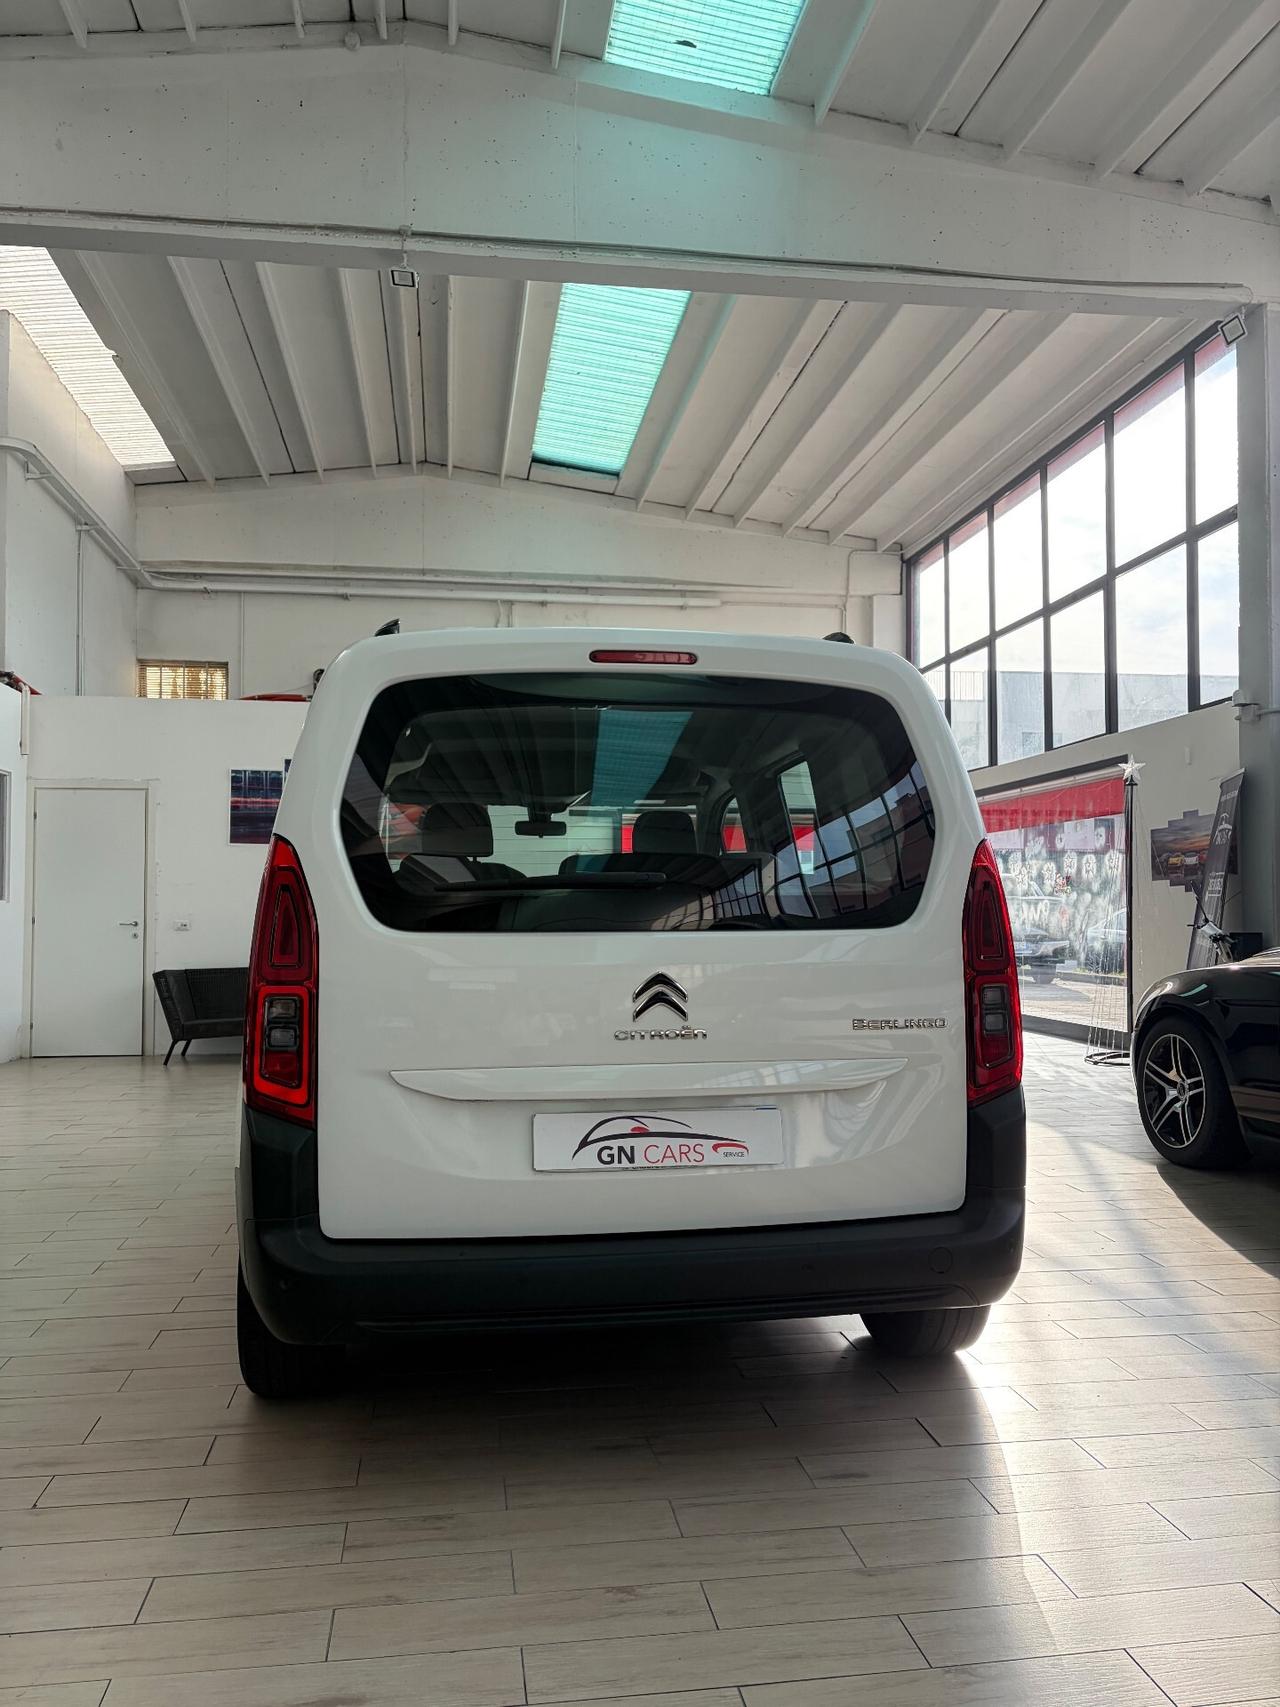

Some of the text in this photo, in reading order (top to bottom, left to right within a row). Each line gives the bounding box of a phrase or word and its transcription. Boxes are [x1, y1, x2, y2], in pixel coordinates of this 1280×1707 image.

[852, 1019, 946, 1030] BERLINGO
[597, 1143, 704, 1165] GN CARS
